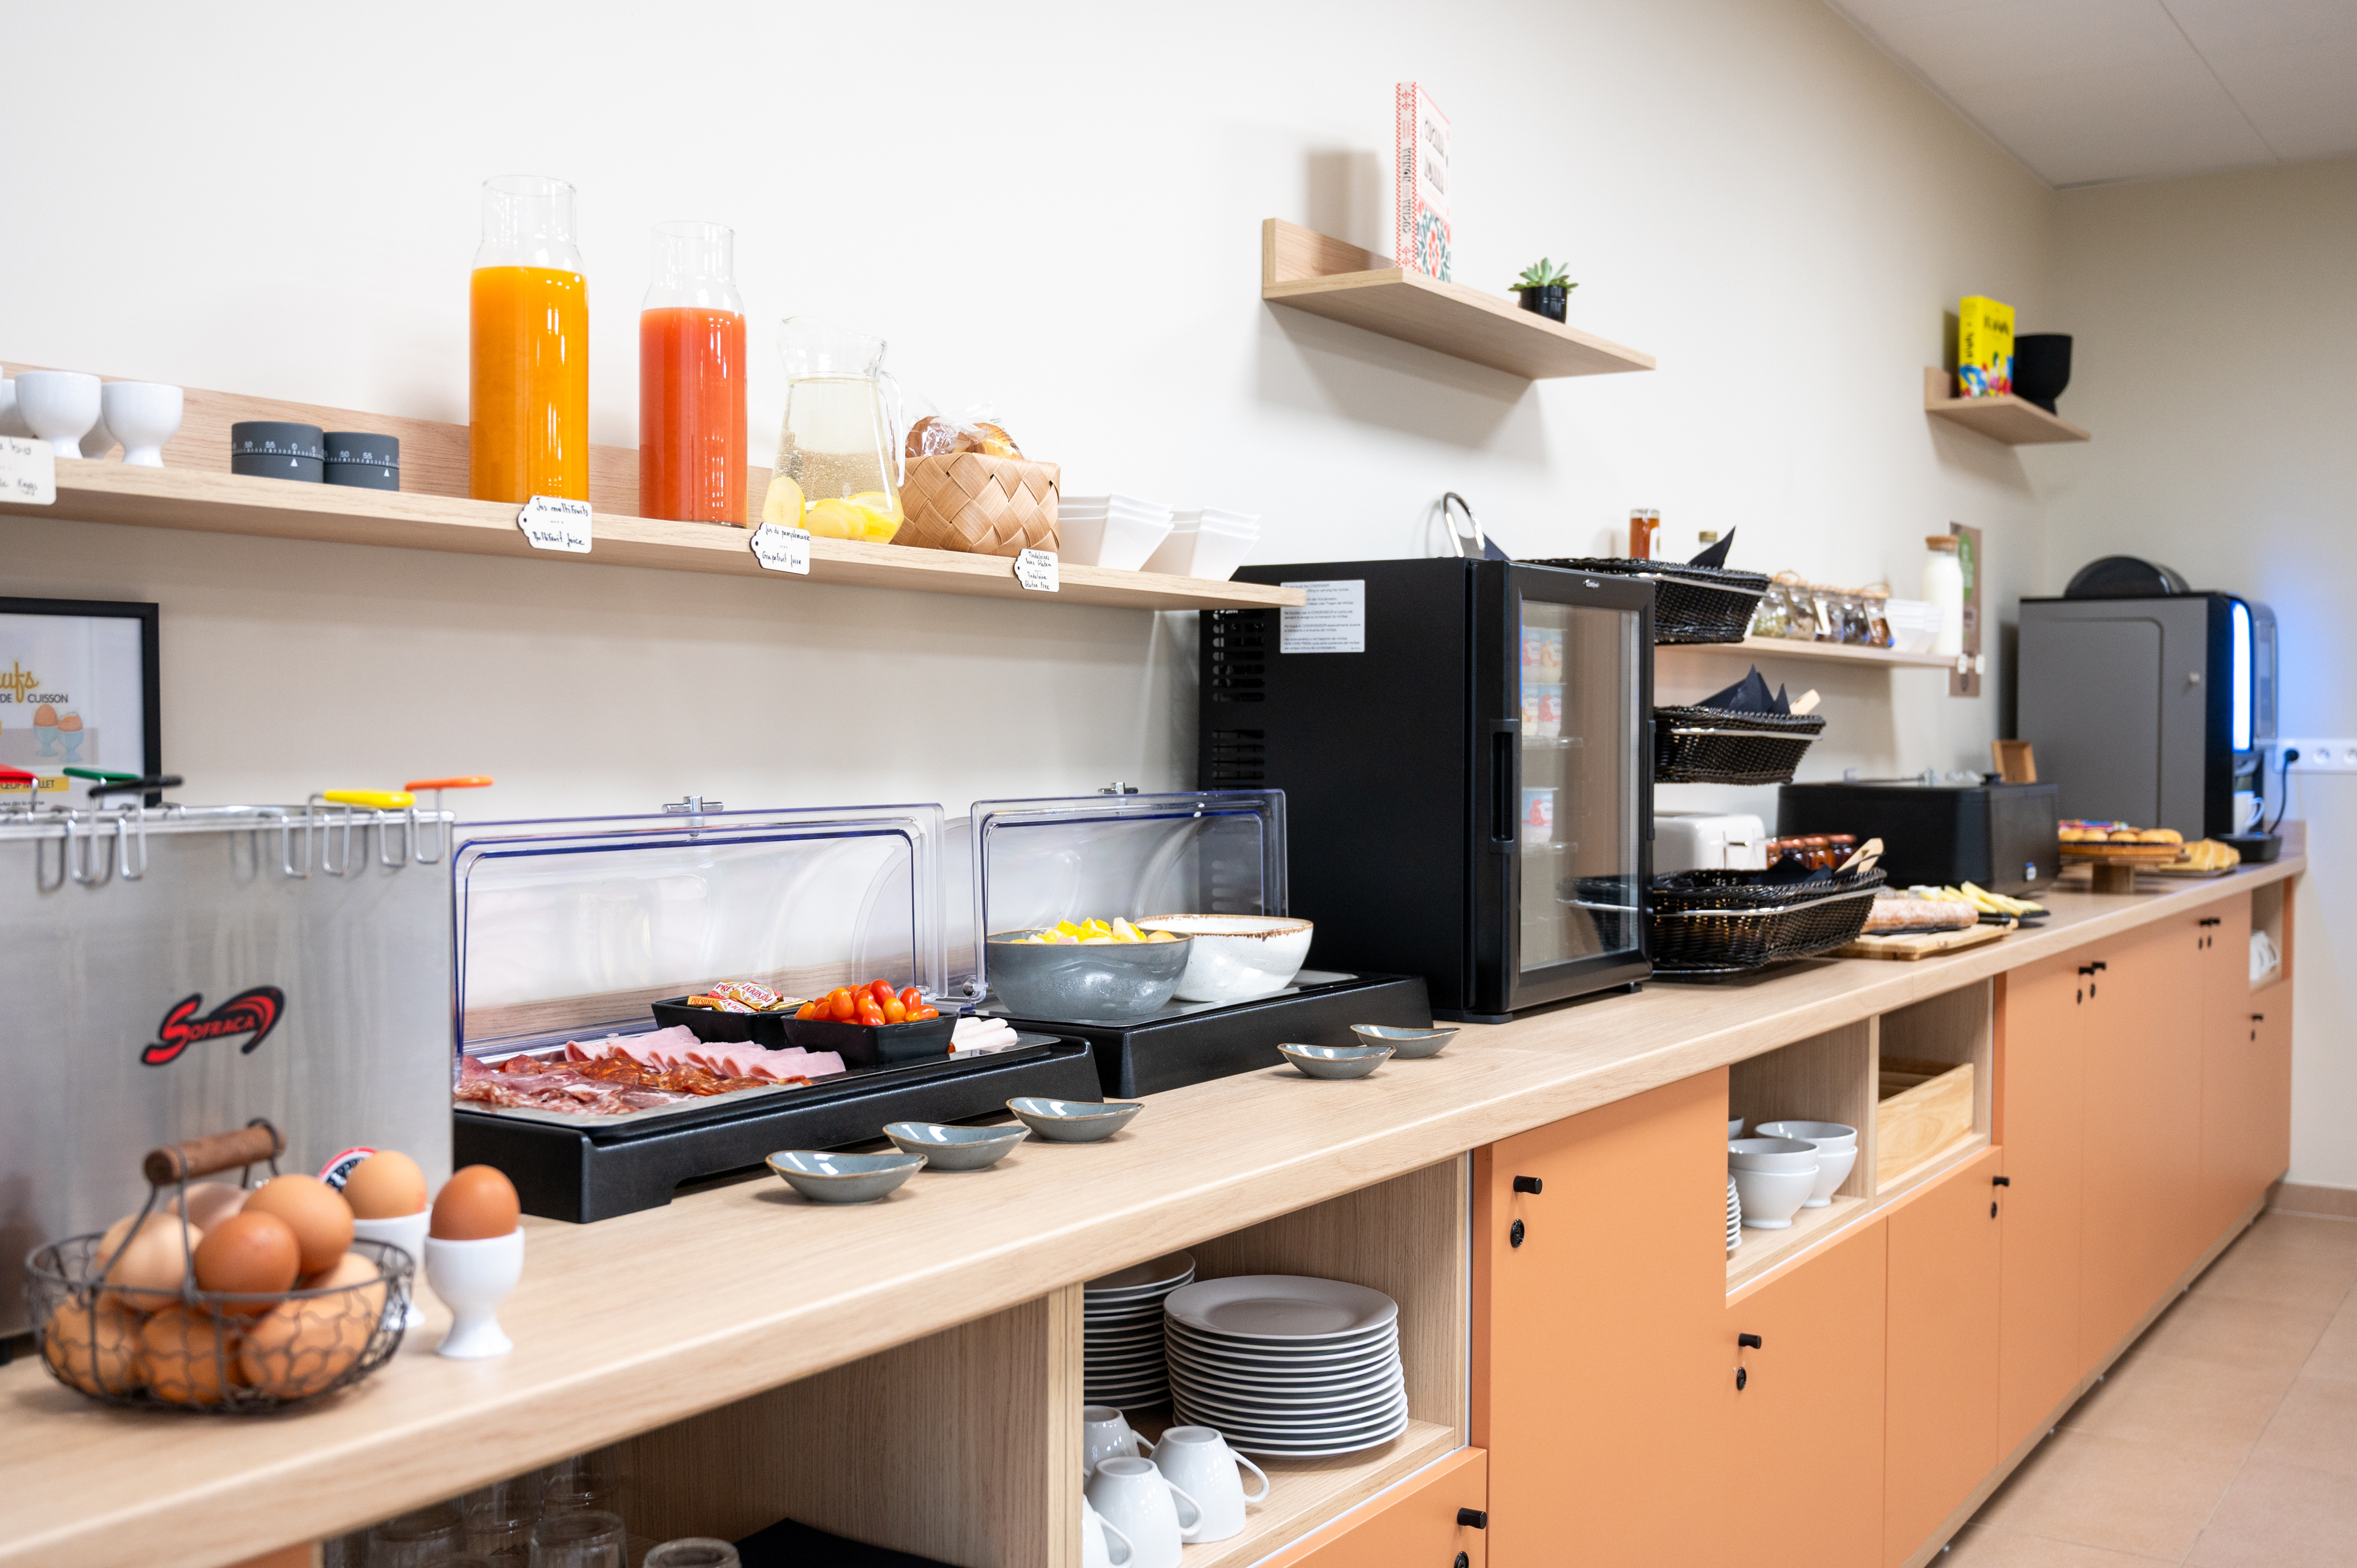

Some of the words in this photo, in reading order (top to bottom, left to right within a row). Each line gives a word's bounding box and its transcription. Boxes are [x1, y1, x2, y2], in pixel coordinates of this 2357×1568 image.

[1402, 147, 1411, 183] NONNA
[1402, 199, 1411, 234] CUCINA
[363, 451, 373, 460] 55
[27, 693, 68, 703] CUISSON
[742, 985, 773, 1003] PRÉSIDENT
[143, 994, 257, 1065] SOFRACA
